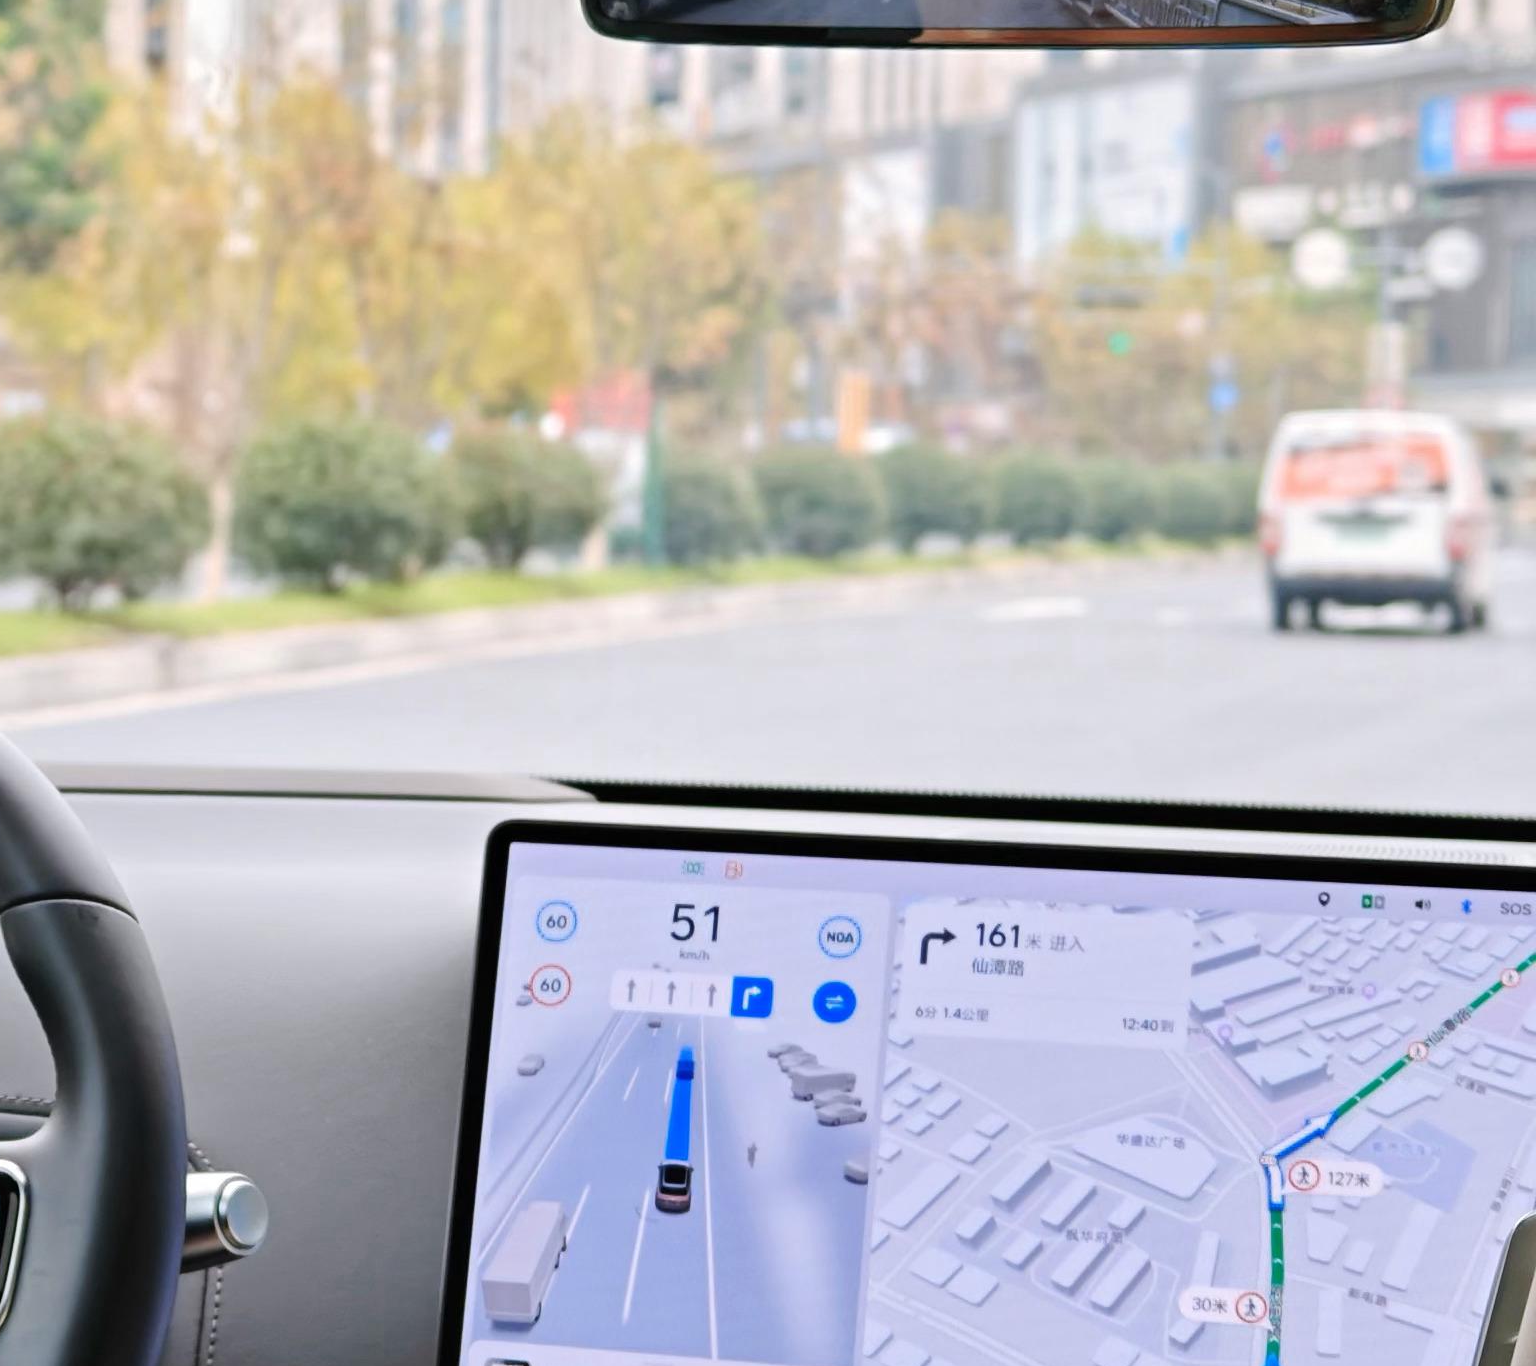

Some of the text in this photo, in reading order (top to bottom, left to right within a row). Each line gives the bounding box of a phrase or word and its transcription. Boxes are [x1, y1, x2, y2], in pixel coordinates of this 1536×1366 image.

[1500, 902, 1531, 915] SOS
[545, 914, 568, 929] 60
[670, 903, 721, 942] 51
[826, 931, 855, 945] NOA
[1049, 935, 1085, 953] 进入
[678, 948, 711, 962] km/h
[971, 957, 1025, 977] 仙潭路
[539, 978, 562, 993] 60
[1327, 1171, 1371, 1187] 127米
[1192, 1297, 1229, 1313] 30米
